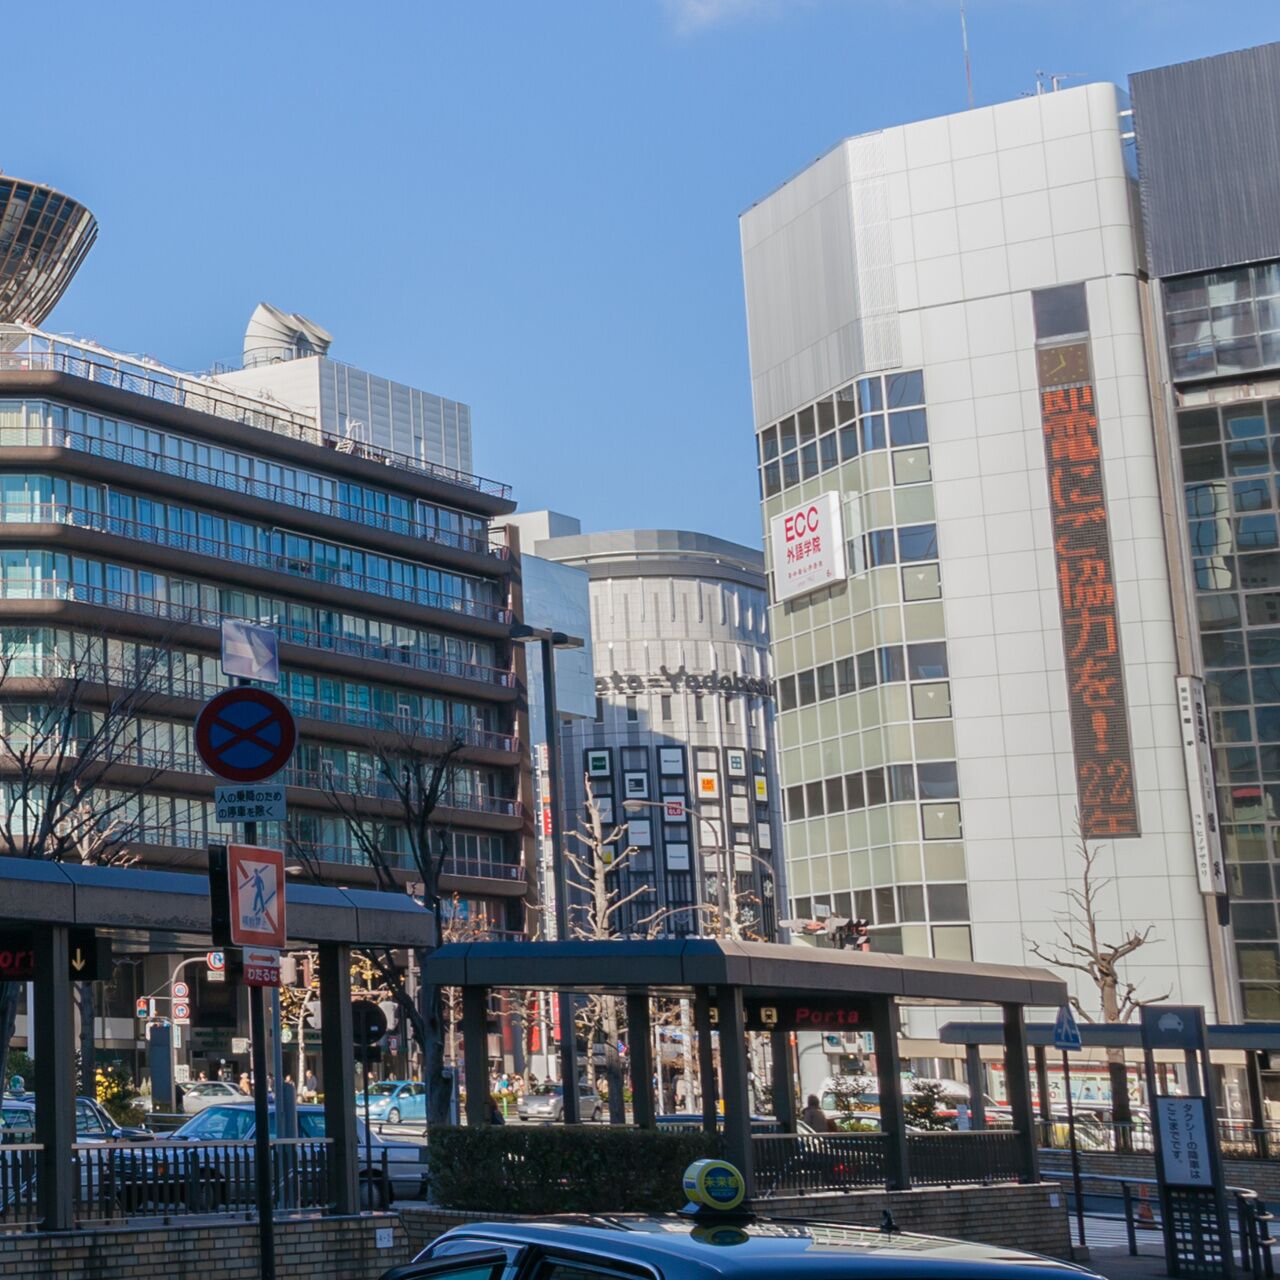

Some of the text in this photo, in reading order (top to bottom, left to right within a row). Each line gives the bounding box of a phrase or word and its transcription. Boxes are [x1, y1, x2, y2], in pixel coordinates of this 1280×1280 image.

[784, 506, 819, 543] ECC
[786, 536, 822, 564] 外語学院
[218, 790, 282, 804] 人の乗降のため
[218, 805, 274, 819] の停車を除く
[247, 968, 278, 982] わたるな
[796, 1007, 860, 1024] Porta
[1166, 1103, 1183, 1164] ここまでです。
[1183, 1103, 1201, 1180] タクシーの降車は
